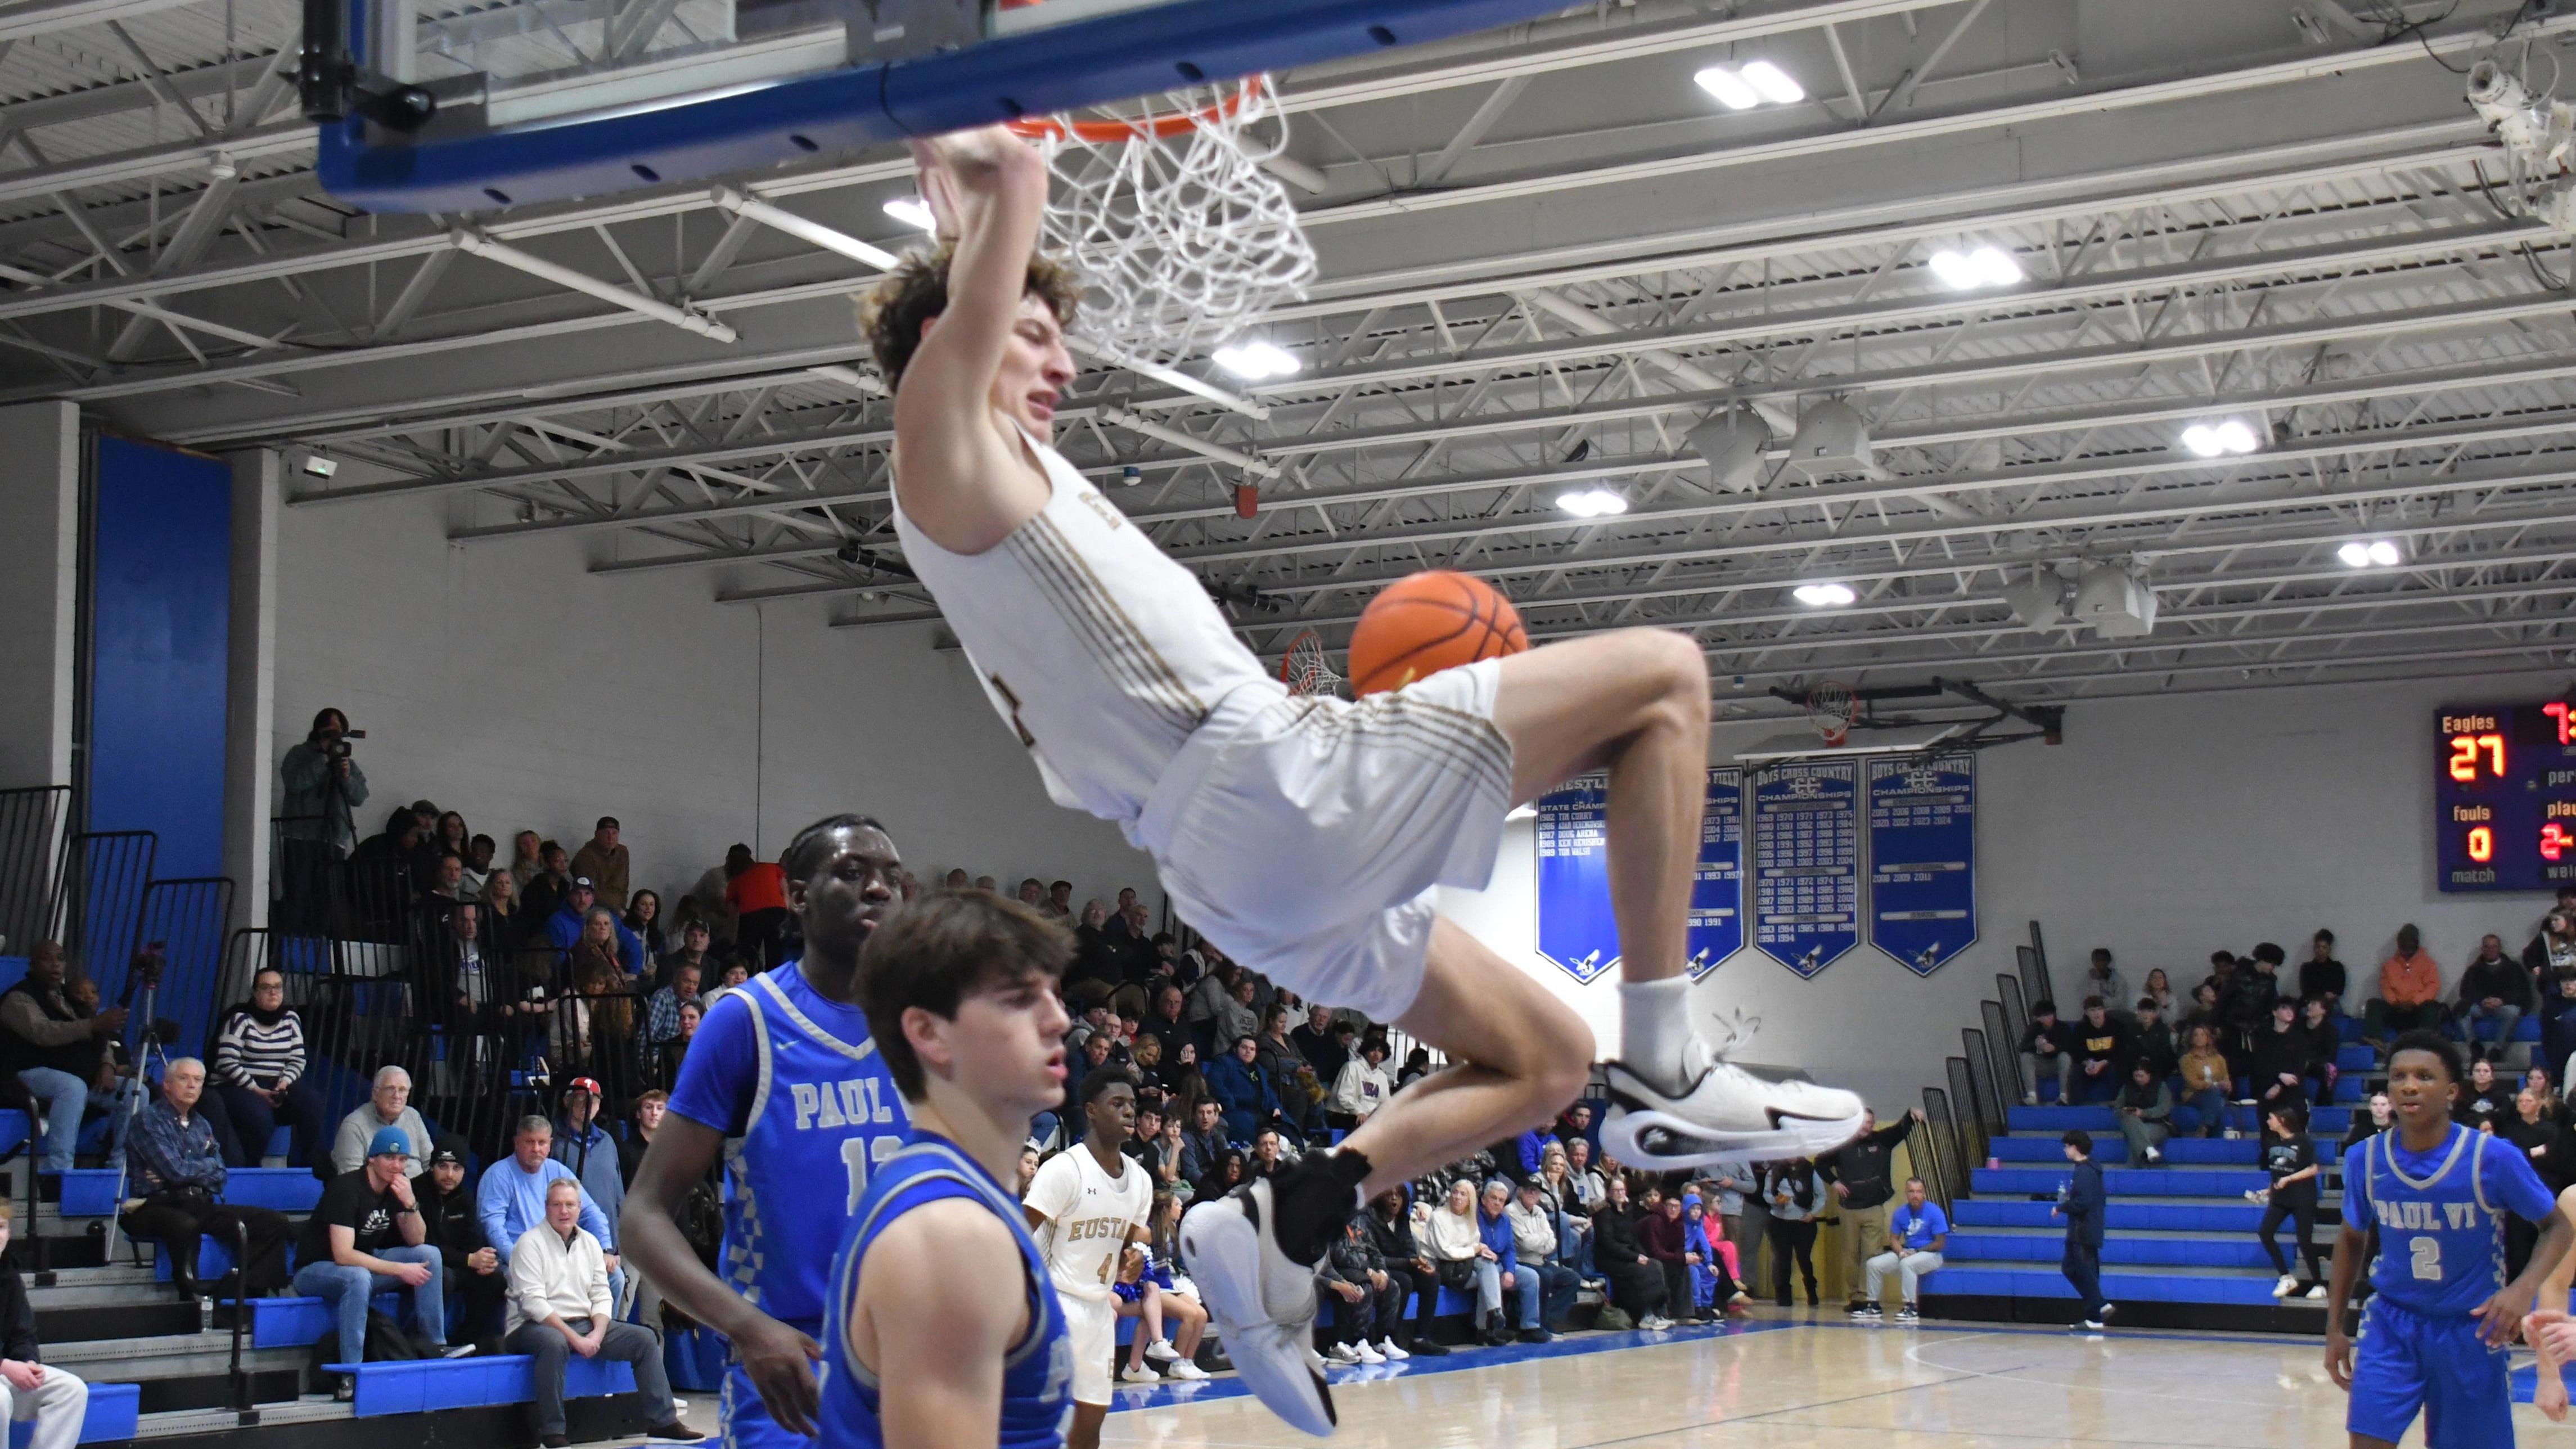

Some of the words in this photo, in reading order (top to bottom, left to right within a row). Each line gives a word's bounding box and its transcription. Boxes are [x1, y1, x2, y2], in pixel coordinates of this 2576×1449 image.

[2442, 716, 2495, 734] Eagles
[2451, 734, 2504, 781] 27
[1713, 771, 1739, 787] FIELD
[1757, 770, 1778, 786] BOYS
[1781, 767, 1809, 780] CROSS
[1811, 766, 1852, 781] COUNTRY
[1871, 763, 1894, 781] BOYS
[1758, 791, 1852, 802] CHAMPIONSHIPS
[1872, 785, 1969, 796] CHAMPIONSHIPS
[2453, 806, 2491, 821] fouls
[2468, 826, 2492, 862] 0
[2452, 868, 2495, 883] match
[791, 1077, 893, 1130] PAUL
[2374, 1200, 2440, 1230] PAUL
[2442, 1203, 2475, 1229] VI
[1068, 1217, 1127, 1241] EUSTA
[2410, 1236, 2441, 1280] 2
[1097, 1253, 1113, 1284] 4
